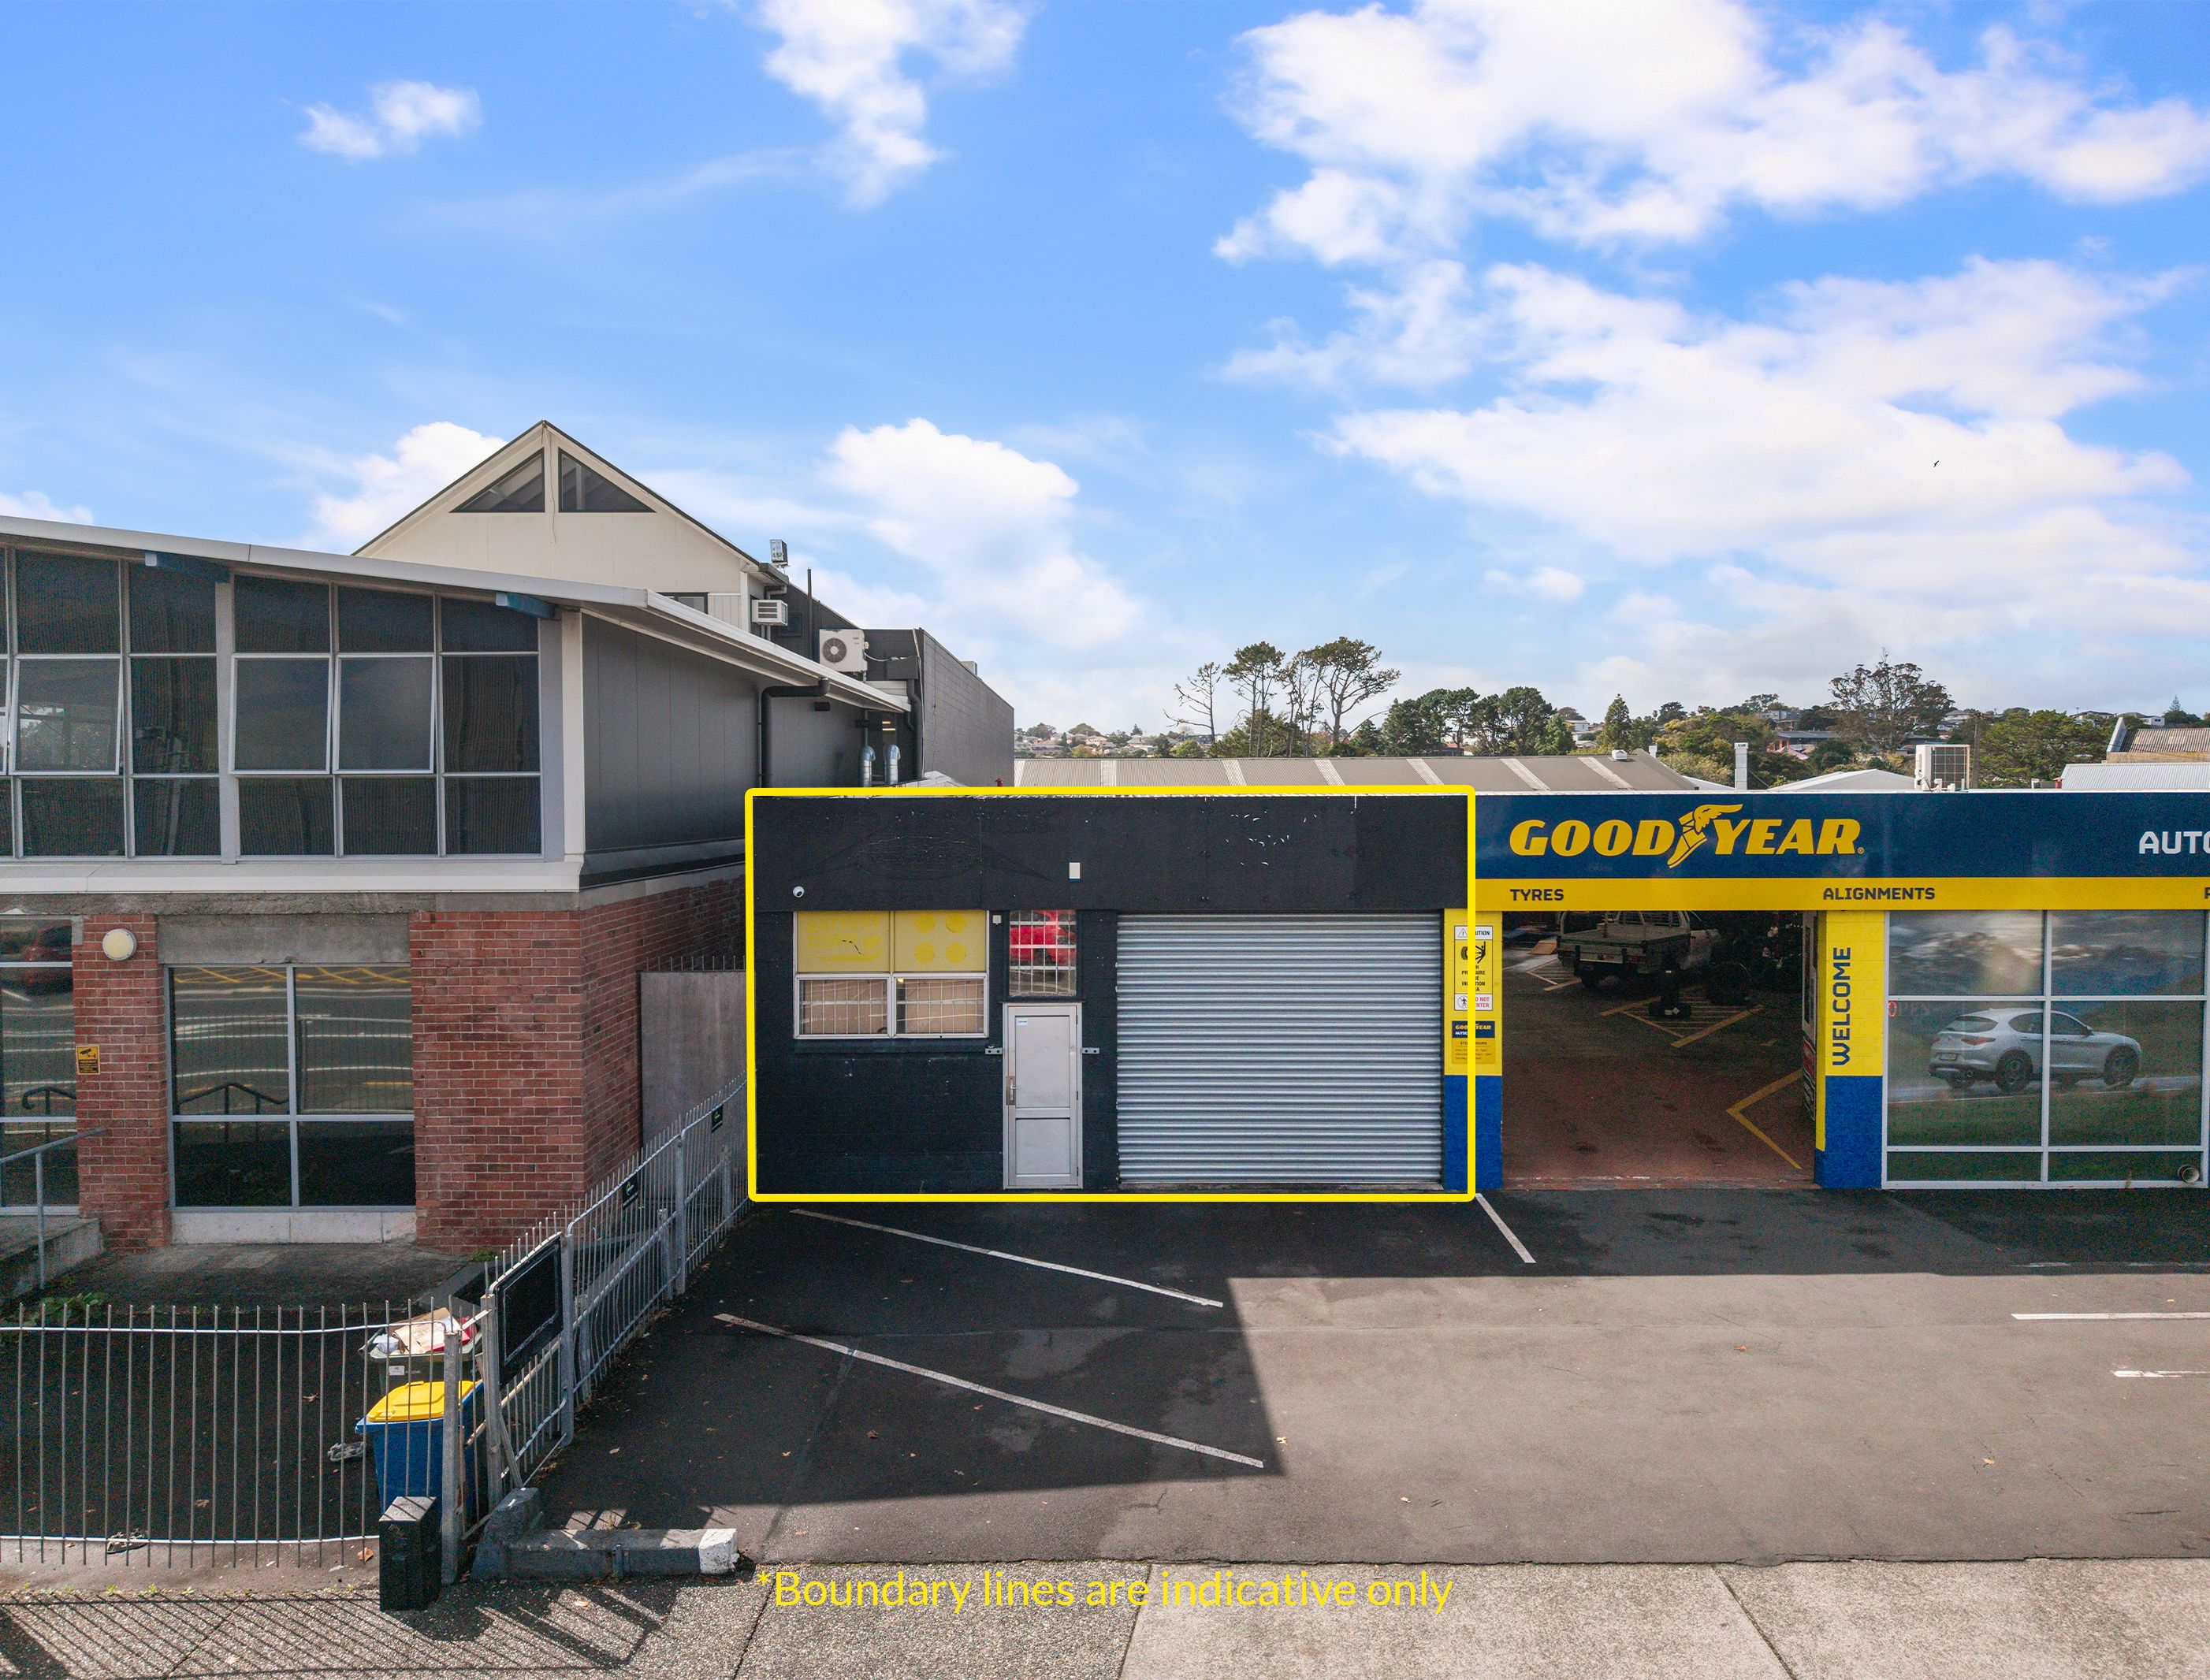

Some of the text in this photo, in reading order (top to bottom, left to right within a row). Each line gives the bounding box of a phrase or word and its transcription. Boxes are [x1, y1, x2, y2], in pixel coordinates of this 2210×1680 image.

[1509, 888, 1564, 901] TYRES
[1822, 887, 1936, 901] ALIGNMENTS
[1832, 947, 1851, 1066] WELCOME
